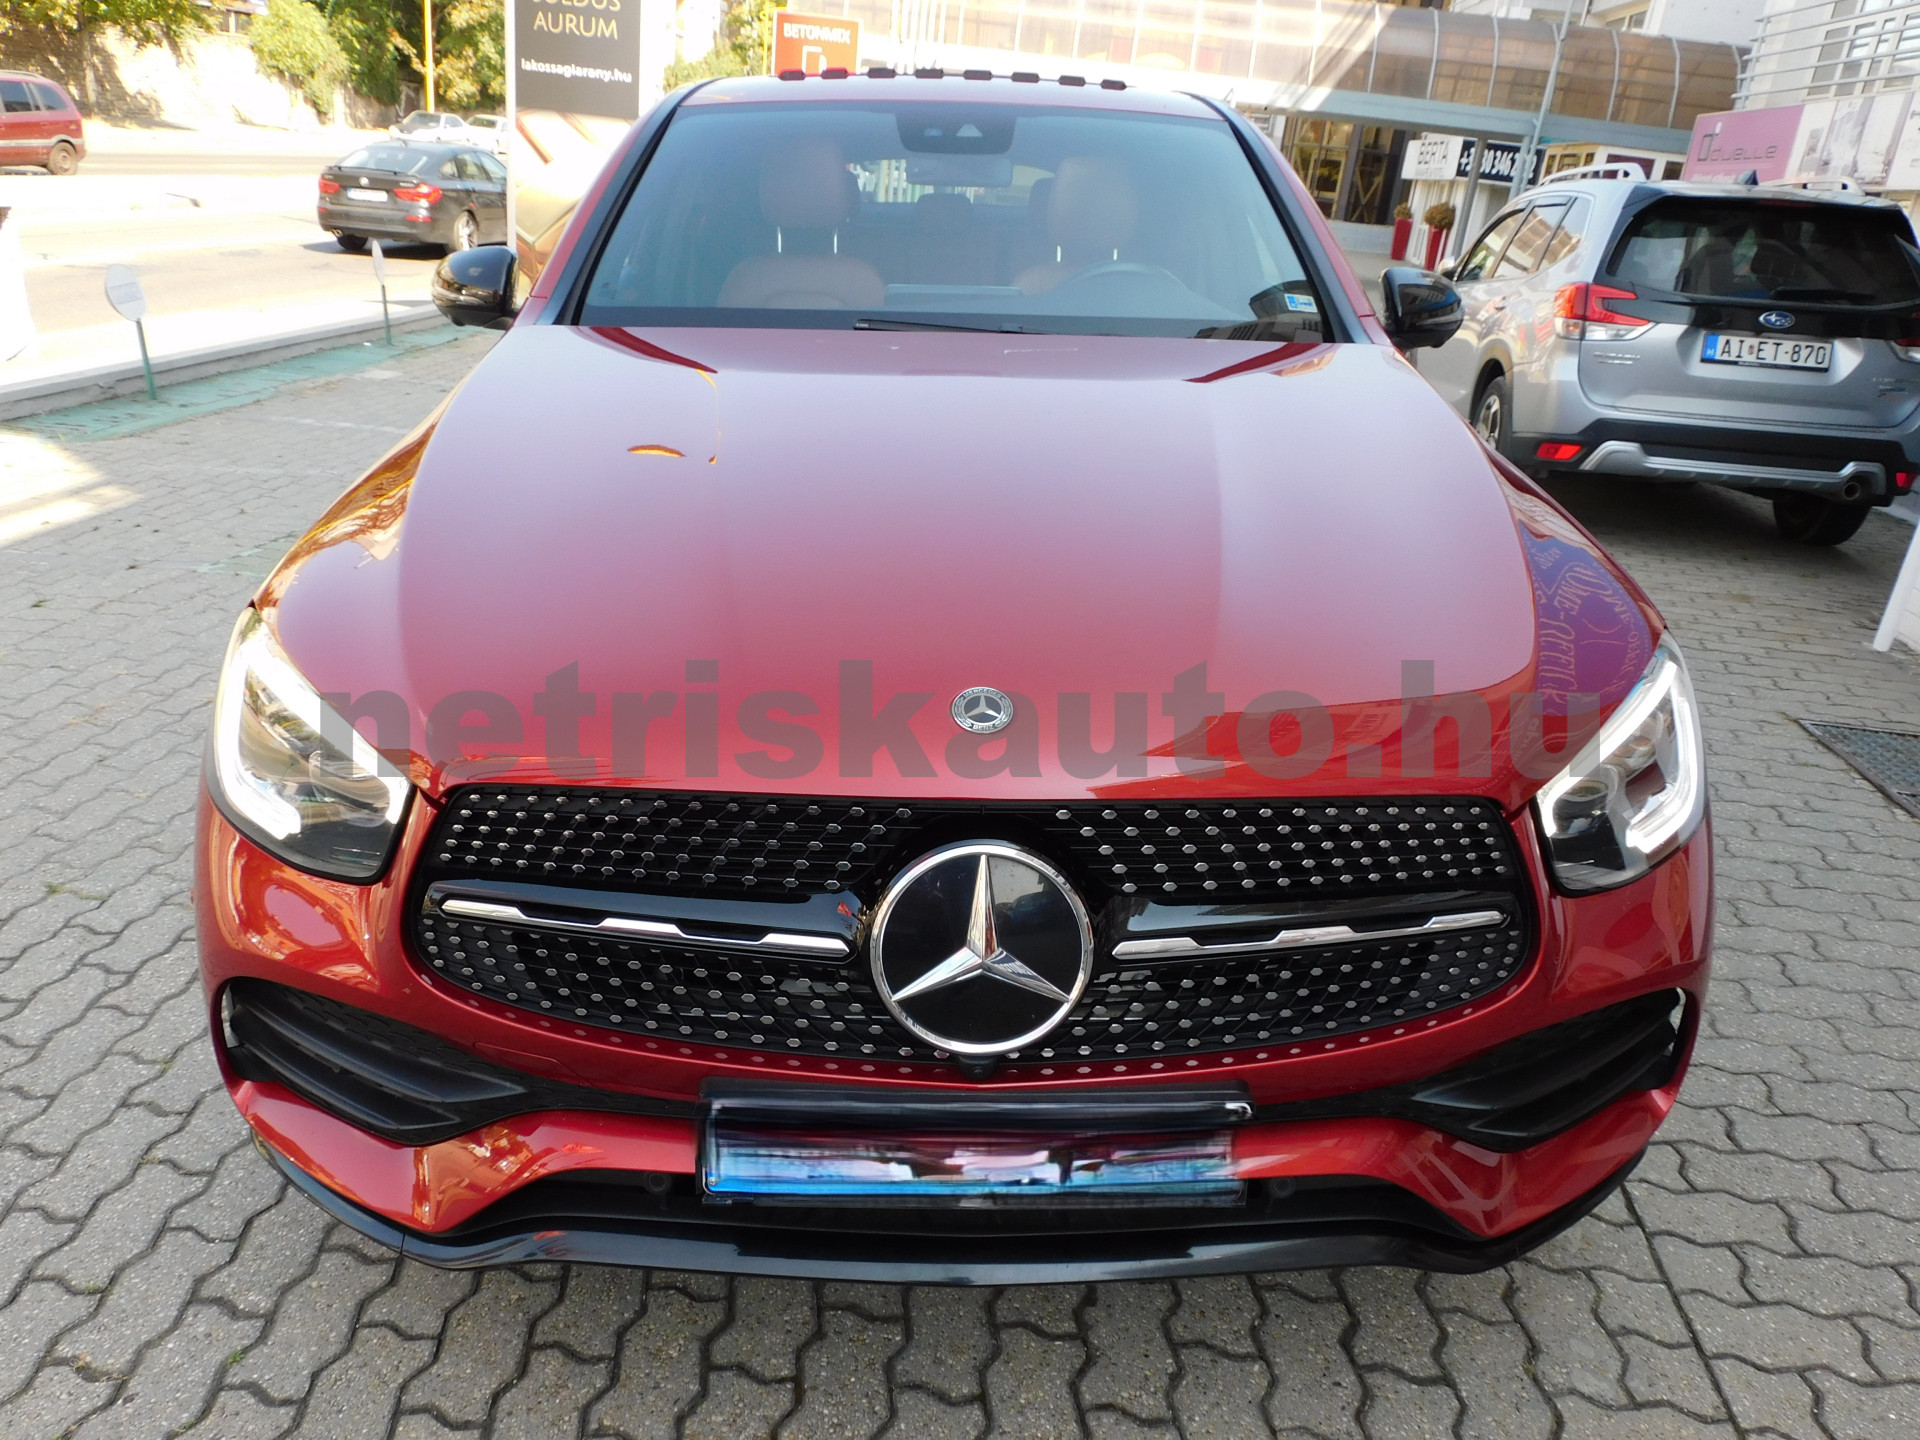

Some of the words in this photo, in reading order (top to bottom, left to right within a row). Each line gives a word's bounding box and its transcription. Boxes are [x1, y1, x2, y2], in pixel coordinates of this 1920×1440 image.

[533, 10, 618, 40] AURUM
[1417, 141, 1449, 165] BERTA
[1720, 338, 1746, 359] AI
[1755, 341, 1827, 365] ET-870
